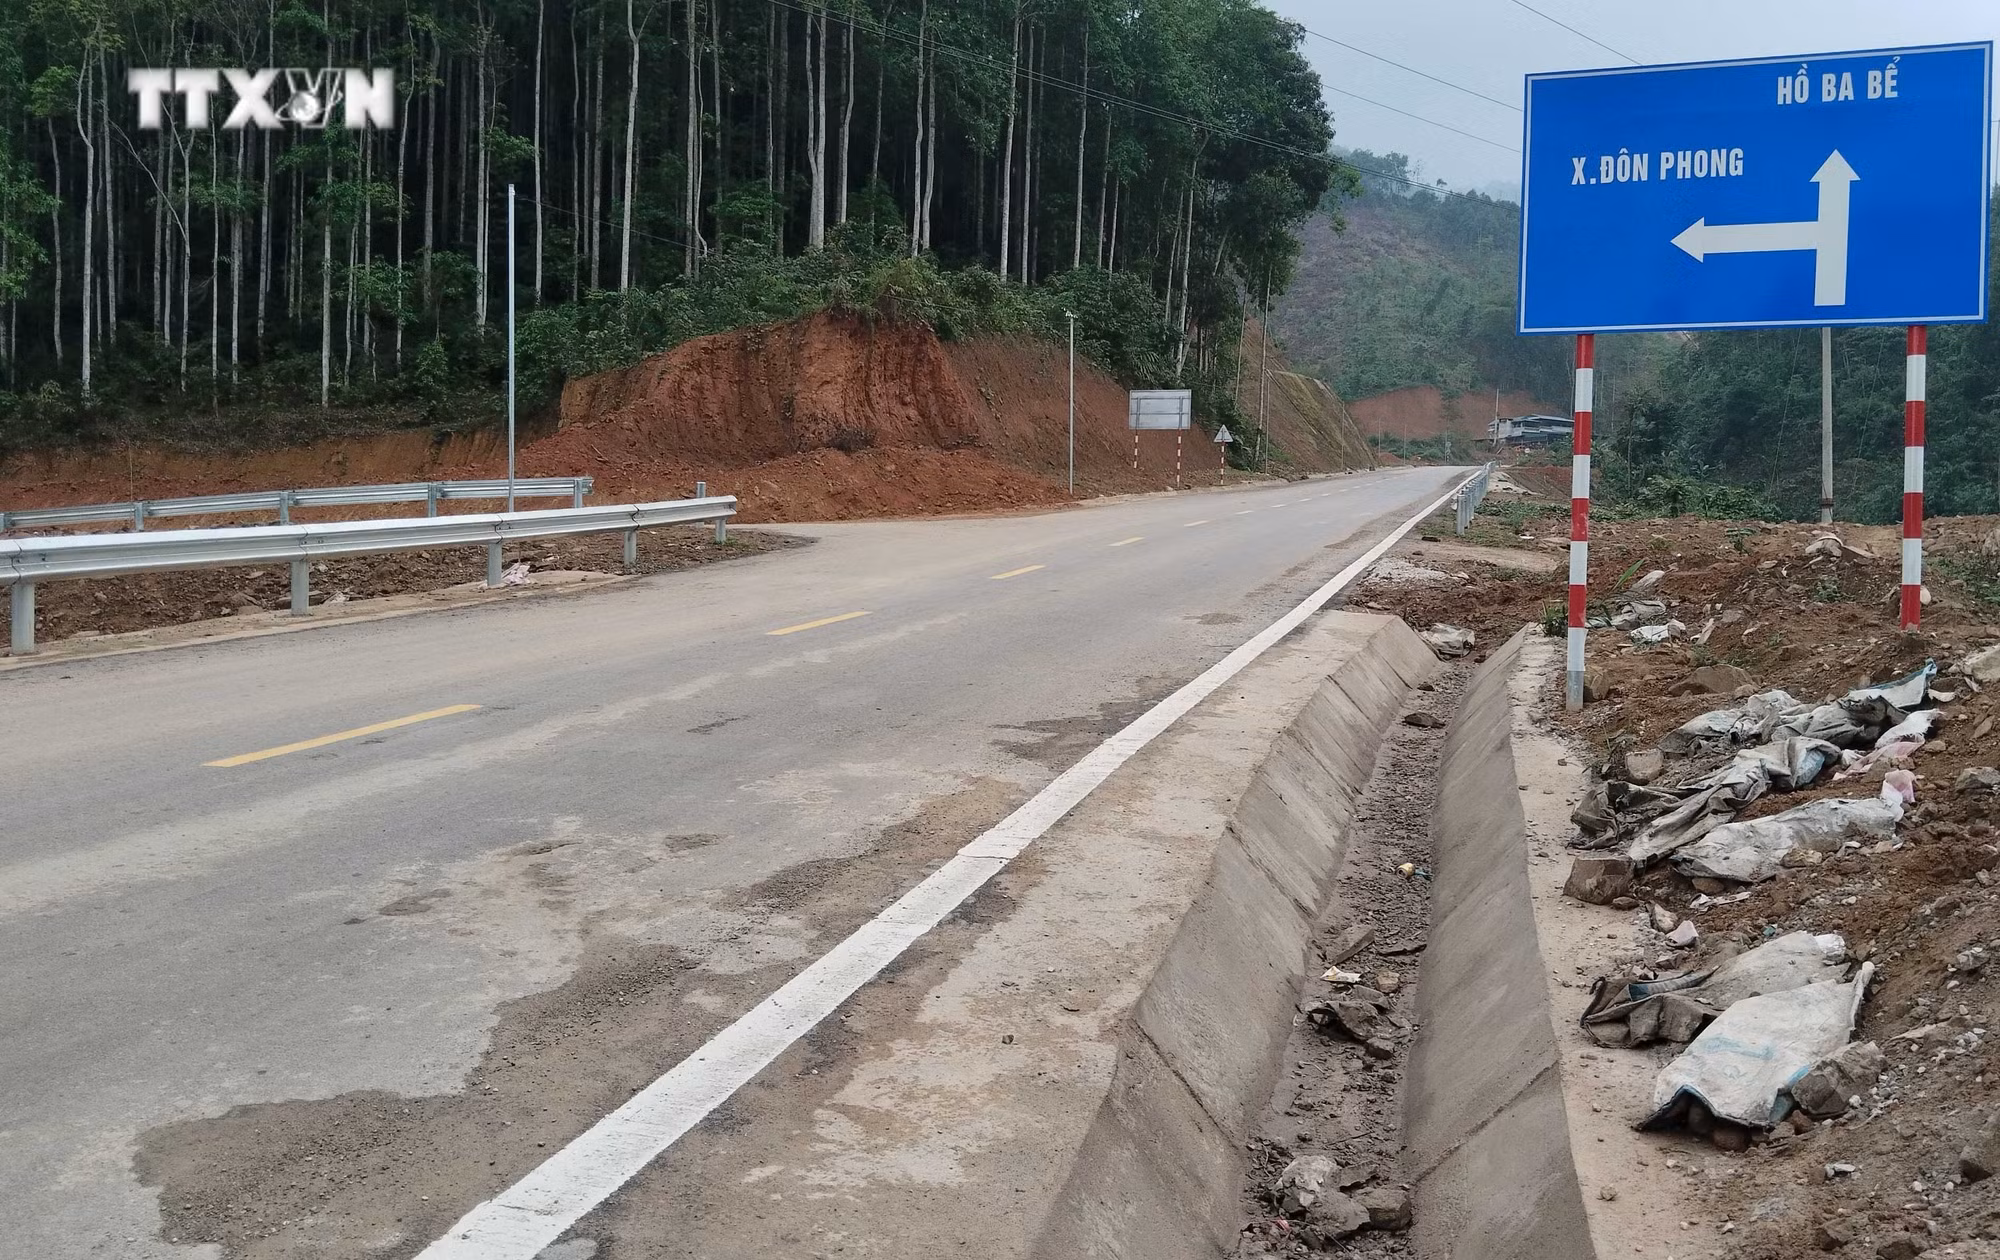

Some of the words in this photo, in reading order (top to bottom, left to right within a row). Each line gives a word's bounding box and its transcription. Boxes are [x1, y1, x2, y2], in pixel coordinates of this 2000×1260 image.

[1777, 63, 1809, 105] HỒ
[1822, 72, 1854, 102] BA
[1867, 56, 1901, 99] BỂ
[1571, 147, 1649, 185] X.ĐÔN
[1660, 148, 1744, 180] PHONG
